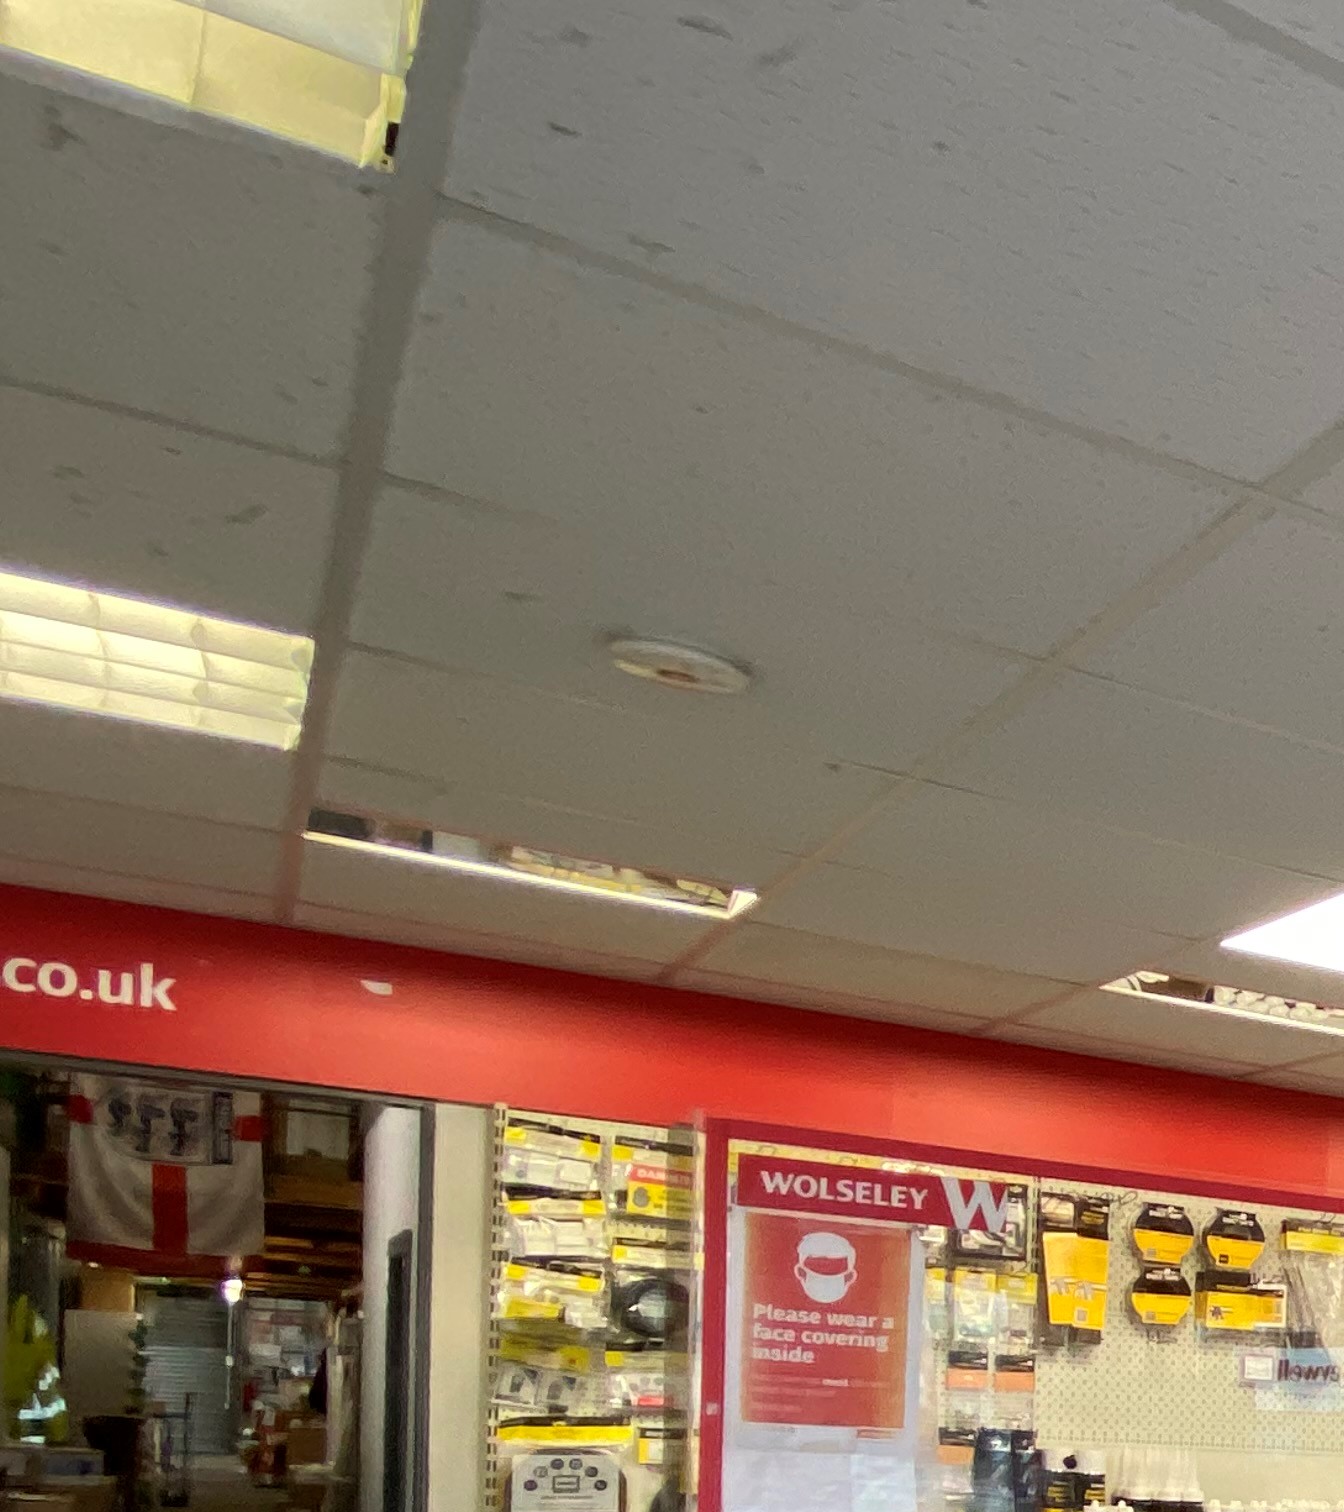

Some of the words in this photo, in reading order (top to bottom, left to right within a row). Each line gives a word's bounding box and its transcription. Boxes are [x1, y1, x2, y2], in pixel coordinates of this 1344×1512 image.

[2, 957, 177, 1011] co.uk
[760, 1170, 928, 1210] WOLSELEY
[940, 1176, 1009, 1232] W
[753, 1303, 821, 1324] Please
[827, 1311, 874, 1329] wear
[882, 1315, 895, 1329] a
[753, 1323, 796, 1342] face
[801, 1328, 889, 1351] covering
[752, 1345, 815, 1364] inside
